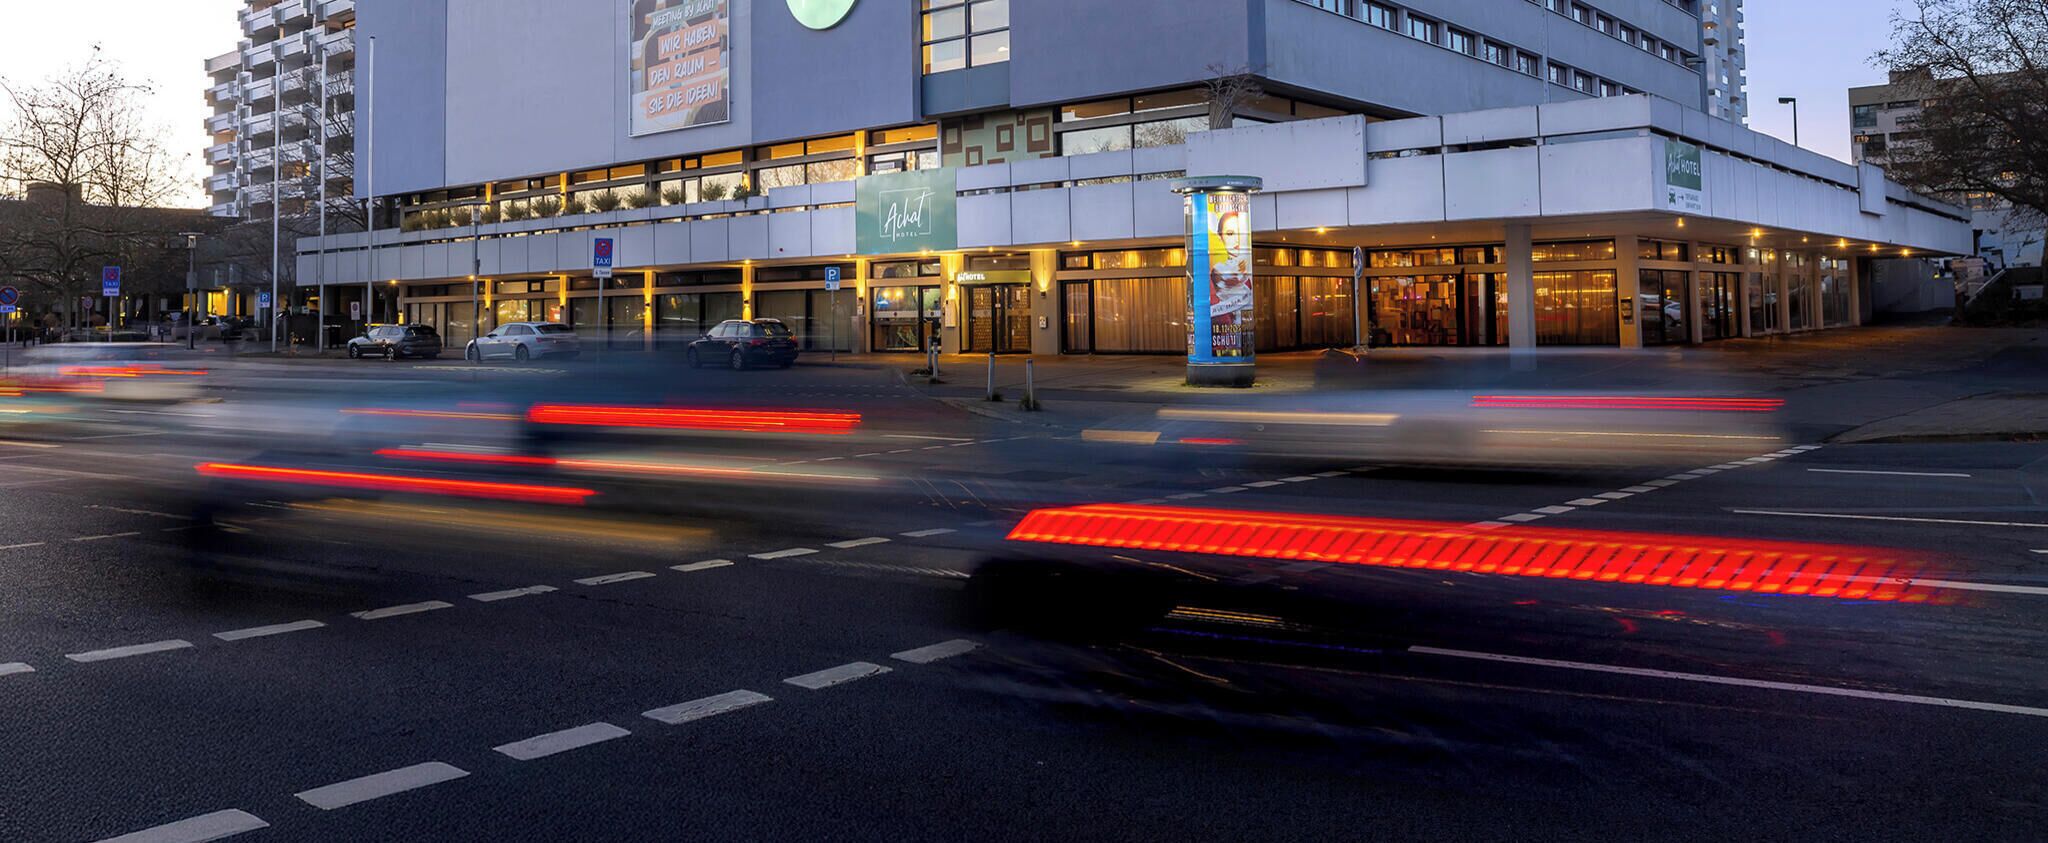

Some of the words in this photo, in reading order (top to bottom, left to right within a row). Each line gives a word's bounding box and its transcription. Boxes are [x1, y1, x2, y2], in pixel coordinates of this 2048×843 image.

[653, 9, 683, 29] MEETING
[685, 5, 694, 16] BY
[661, 34, 680, 53] WIR
[684, 24, 716, 48] HABEN
[651, 66, 670, 86] DEN
[674, 56, 704, 78] RAUM
[648, 96, 664, 114] SIE
[666, 91, 683, 110] DIE
[686, 80, 718, 104] IDEEN!
[1681, 160, 1700, 176] HOTEL
[884, 191, 936, 242] Achat
[595, 257, 611, 265] TAXI
